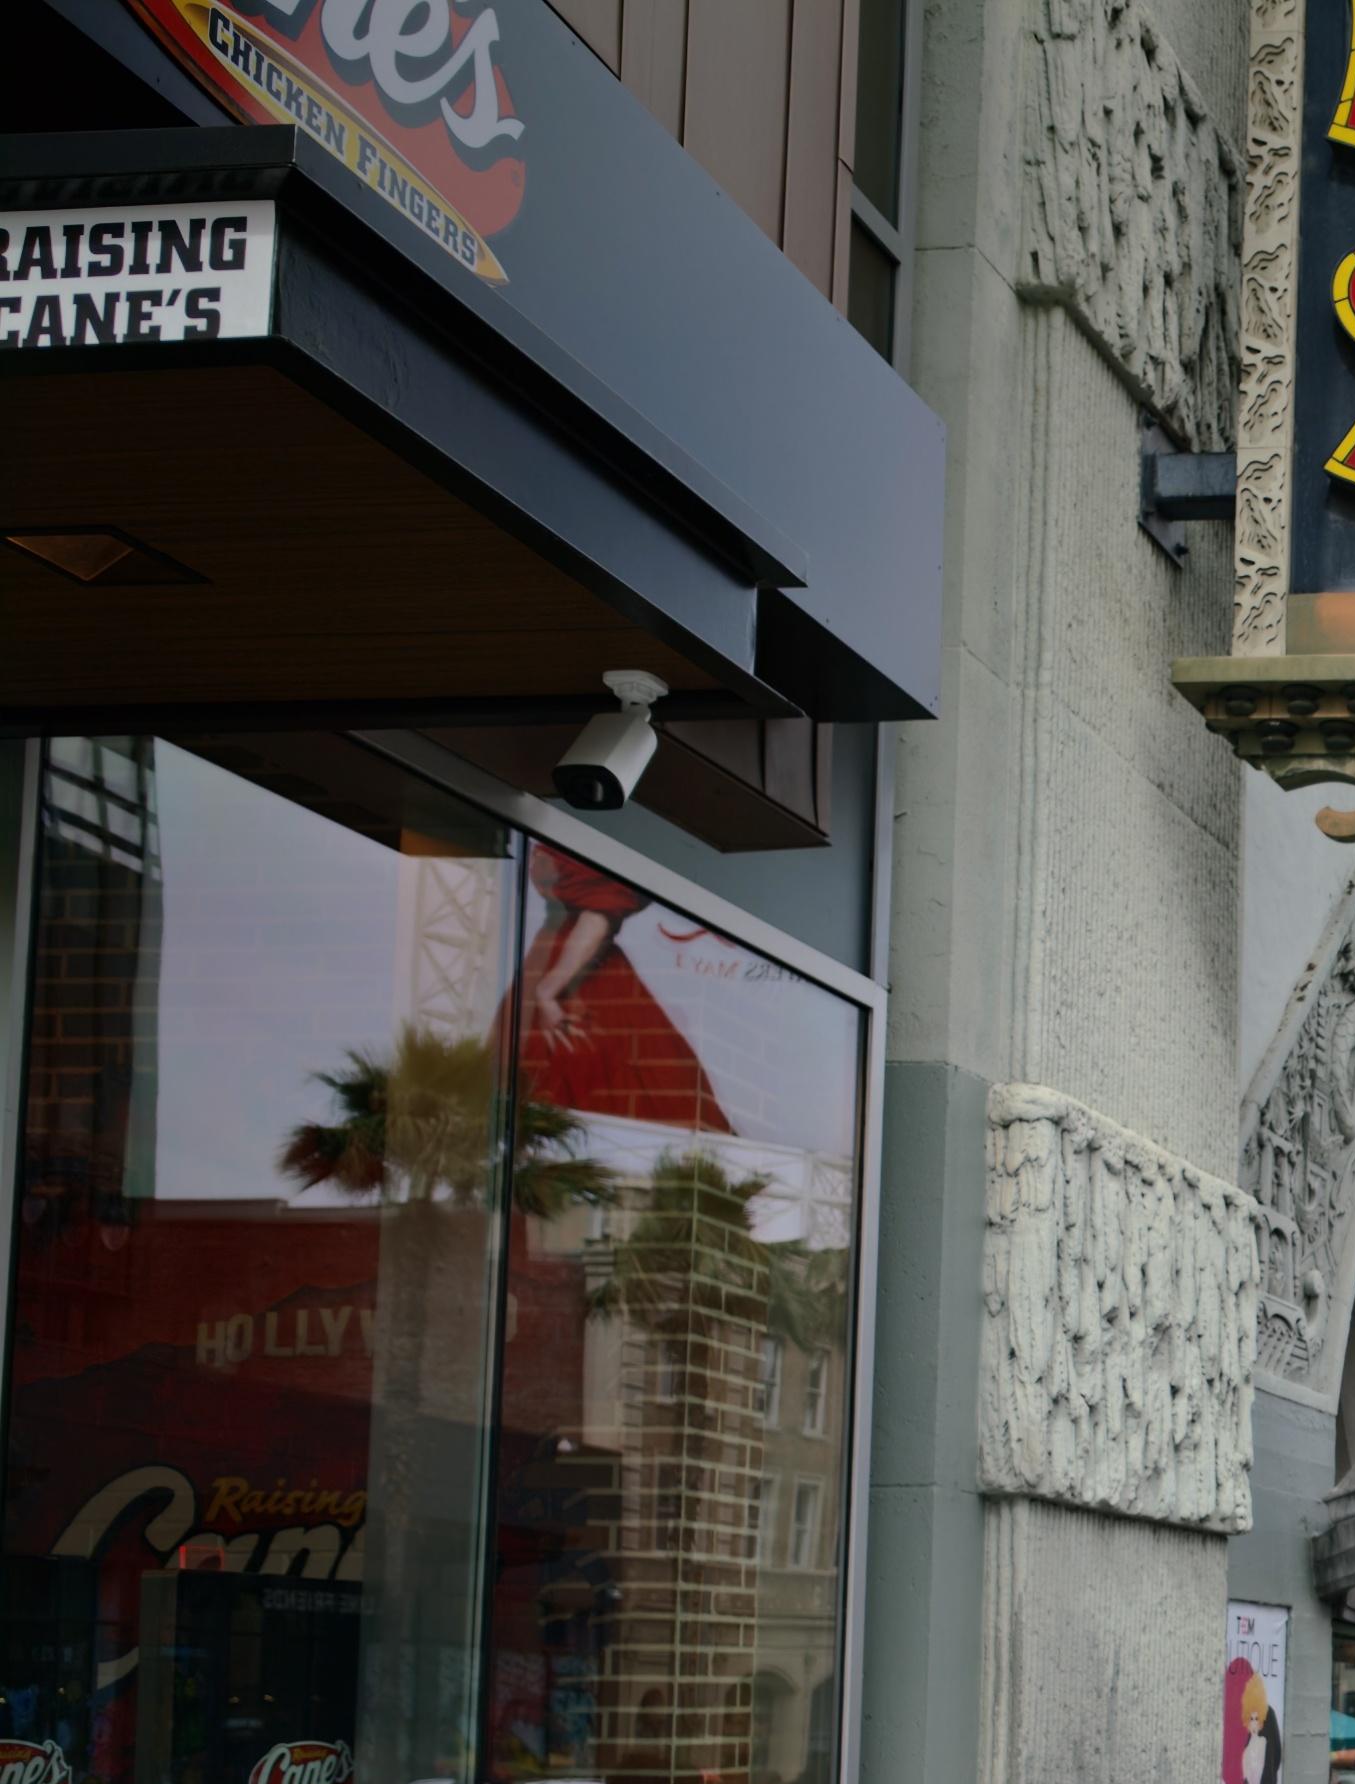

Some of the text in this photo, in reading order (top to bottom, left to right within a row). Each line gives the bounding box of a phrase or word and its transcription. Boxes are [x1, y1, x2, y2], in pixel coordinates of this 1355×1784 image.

[208, 8, 478, 268] CHICKEN FINGERS
[0, 216, 247, 282] AISING
[205, 1477, 366, 1526] Raising
